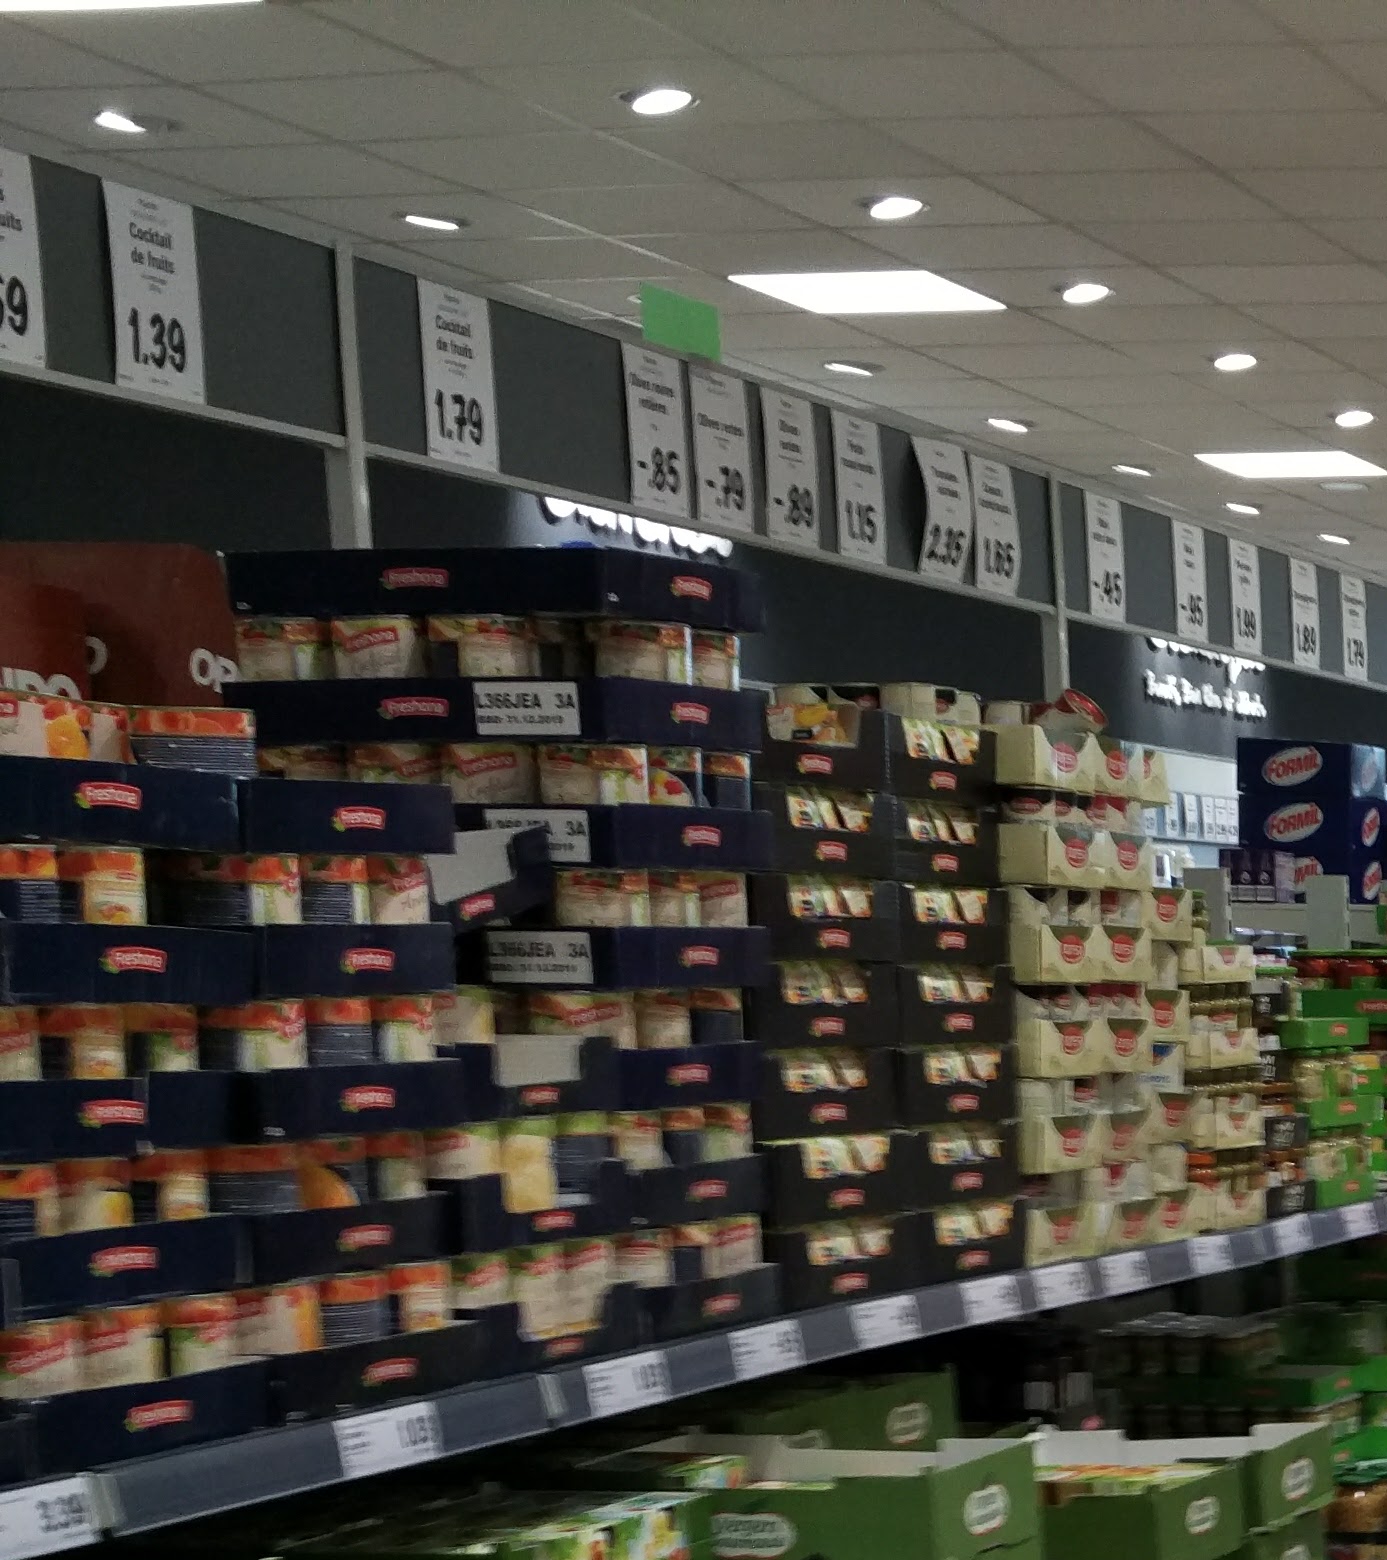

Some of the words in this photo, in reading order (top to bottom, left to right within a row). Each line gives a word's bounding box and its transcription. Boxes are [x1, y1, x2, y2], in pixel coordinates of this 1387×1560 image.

[129, 221, 173, 250] Cocktail
[130, 247, 145, 265] de
[147, 251, 176, 275] fruits
[435, 314, 472, 338] Cocktail
[127, 306, 187, 374] 1.39
[433, 387, 484, 447] 1.79
[554, 692, 575, 709] 3A
[1266, 753, 1320, 780] FORMIL
[566, 820, 587, 836] 3A
[1268, 808, 1321, 835] FORMIL
